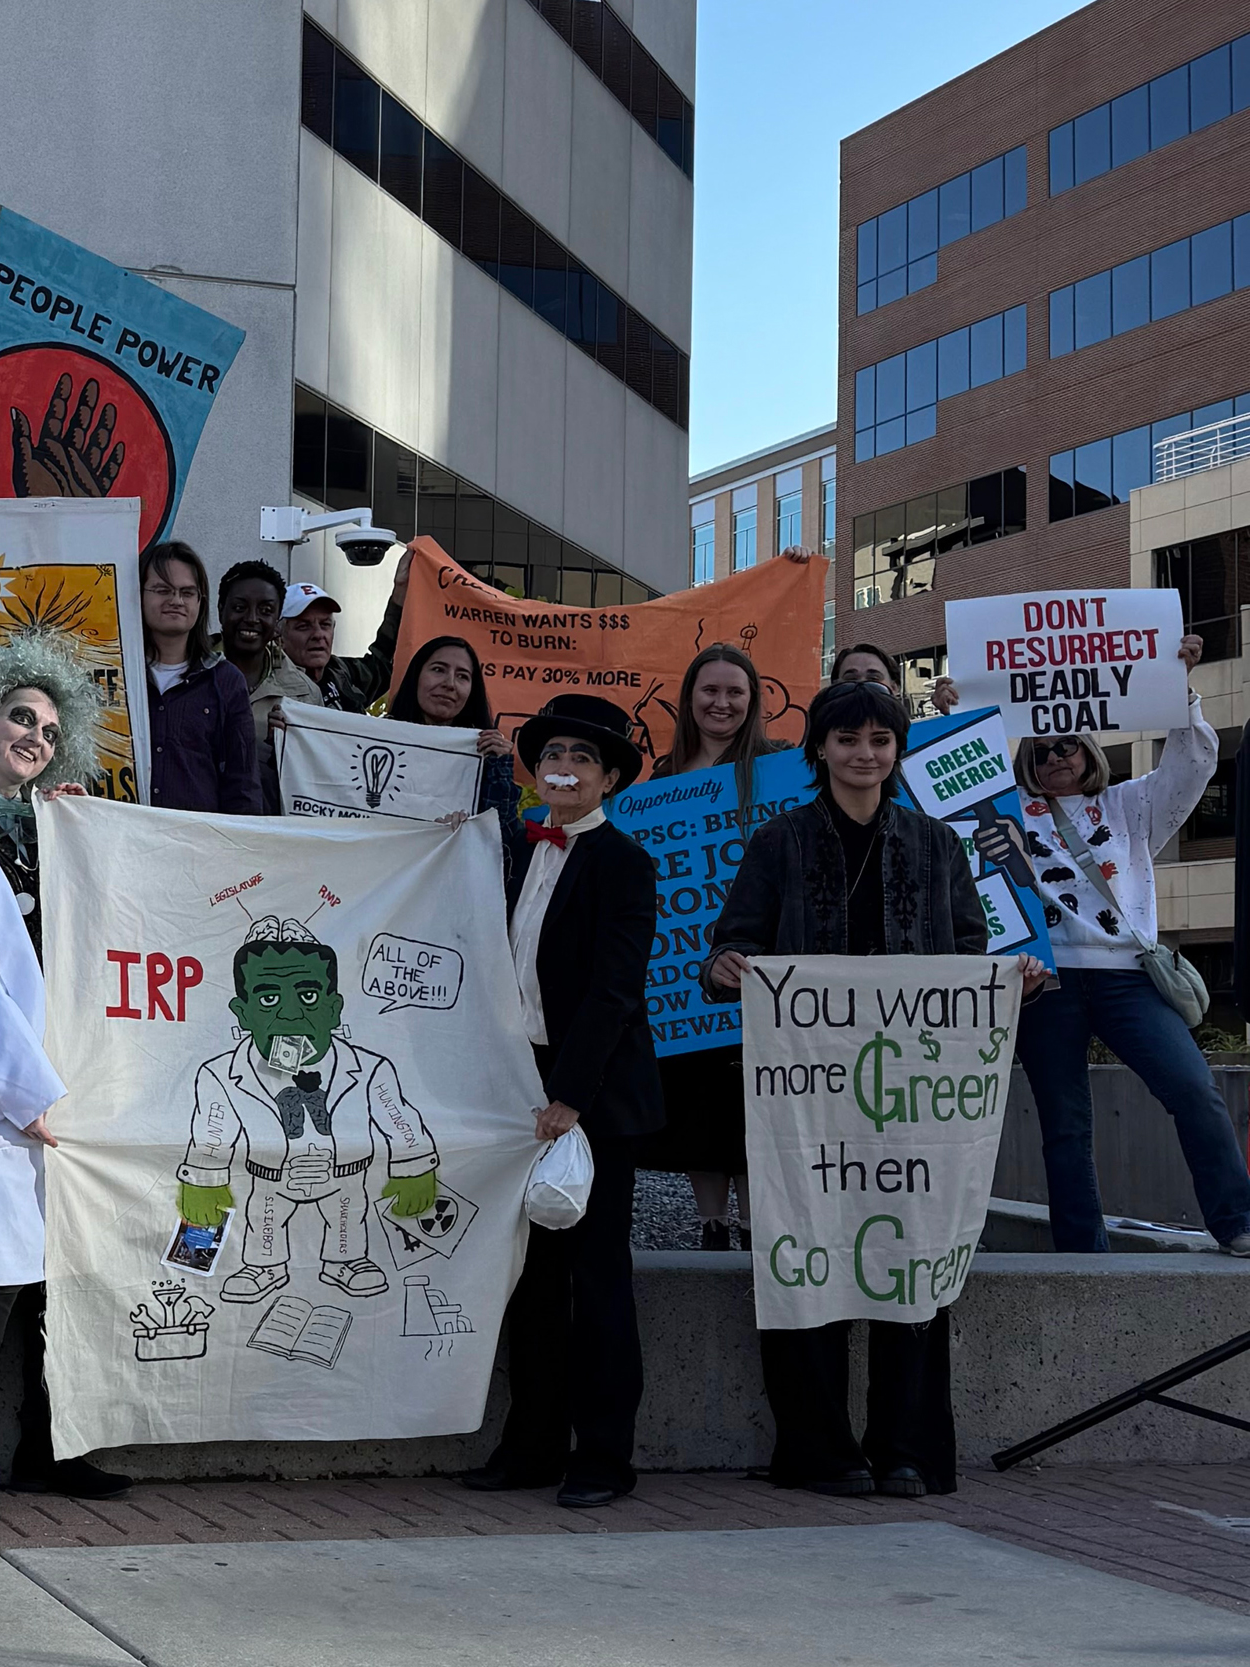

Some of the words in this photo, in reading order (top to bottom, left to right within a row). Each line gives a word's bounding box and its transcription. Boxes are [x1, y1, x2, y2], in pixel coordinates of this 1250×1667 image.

[114, 327, 220, 395] POWER
[444, 603, 517, 627] WARREN
[521, 613, 592, 630] WANTS
[598, 613, 631, 631] $$$
[1023, 598, 1107, 632] DON'T
[490, 630, 513, 646] TO
[517, 633, 577, 651] BURN:
[986, 628, 1159, 671] RESURRECT
[502, 665, 538, 682] PAY
[542, 667, 580, 684] 30%
[586, 670, 642, 687] MORE
[1010, 664, 1133, 703] DEADLY
[1031, 700, 1120, 735] COAL
[925, 737, 990, 780] GREEN
[932, 753, 1008, 802] ENERGY
[293, 799, 336, 818] ROCKY
[618, 778, 724, 818] Opportunity
[632, 820, 698, 848] PSC:
[702, 797, 800, 834] BRING
[209, 872, 264, 907] LEGISLATURE
[318, 884, 341, 907] RMP
[373, 943, 406, 963] ALL
[417, 951, 442, 968] OF
[391, 965, 425, 984] THE
[106, 949, 203, 1023] IRP
[369, 977, 447, 1001] ABOVE!!!
[753, 964, 856, 1029] You
[877, 962, 1006, 1028] want
[755, 1063, 846, 1096] more
[202, 1101, 226, 1159] HUNTER
[374, 1083, 420, 1149] HUNTINGTON
[812, 1141, 930, 1193] then
[261, 1195, 274, 1257] LOBBYISTS
[770, 1233, 830, 1288] Go
[854, 1214, 972, 1305] Green
